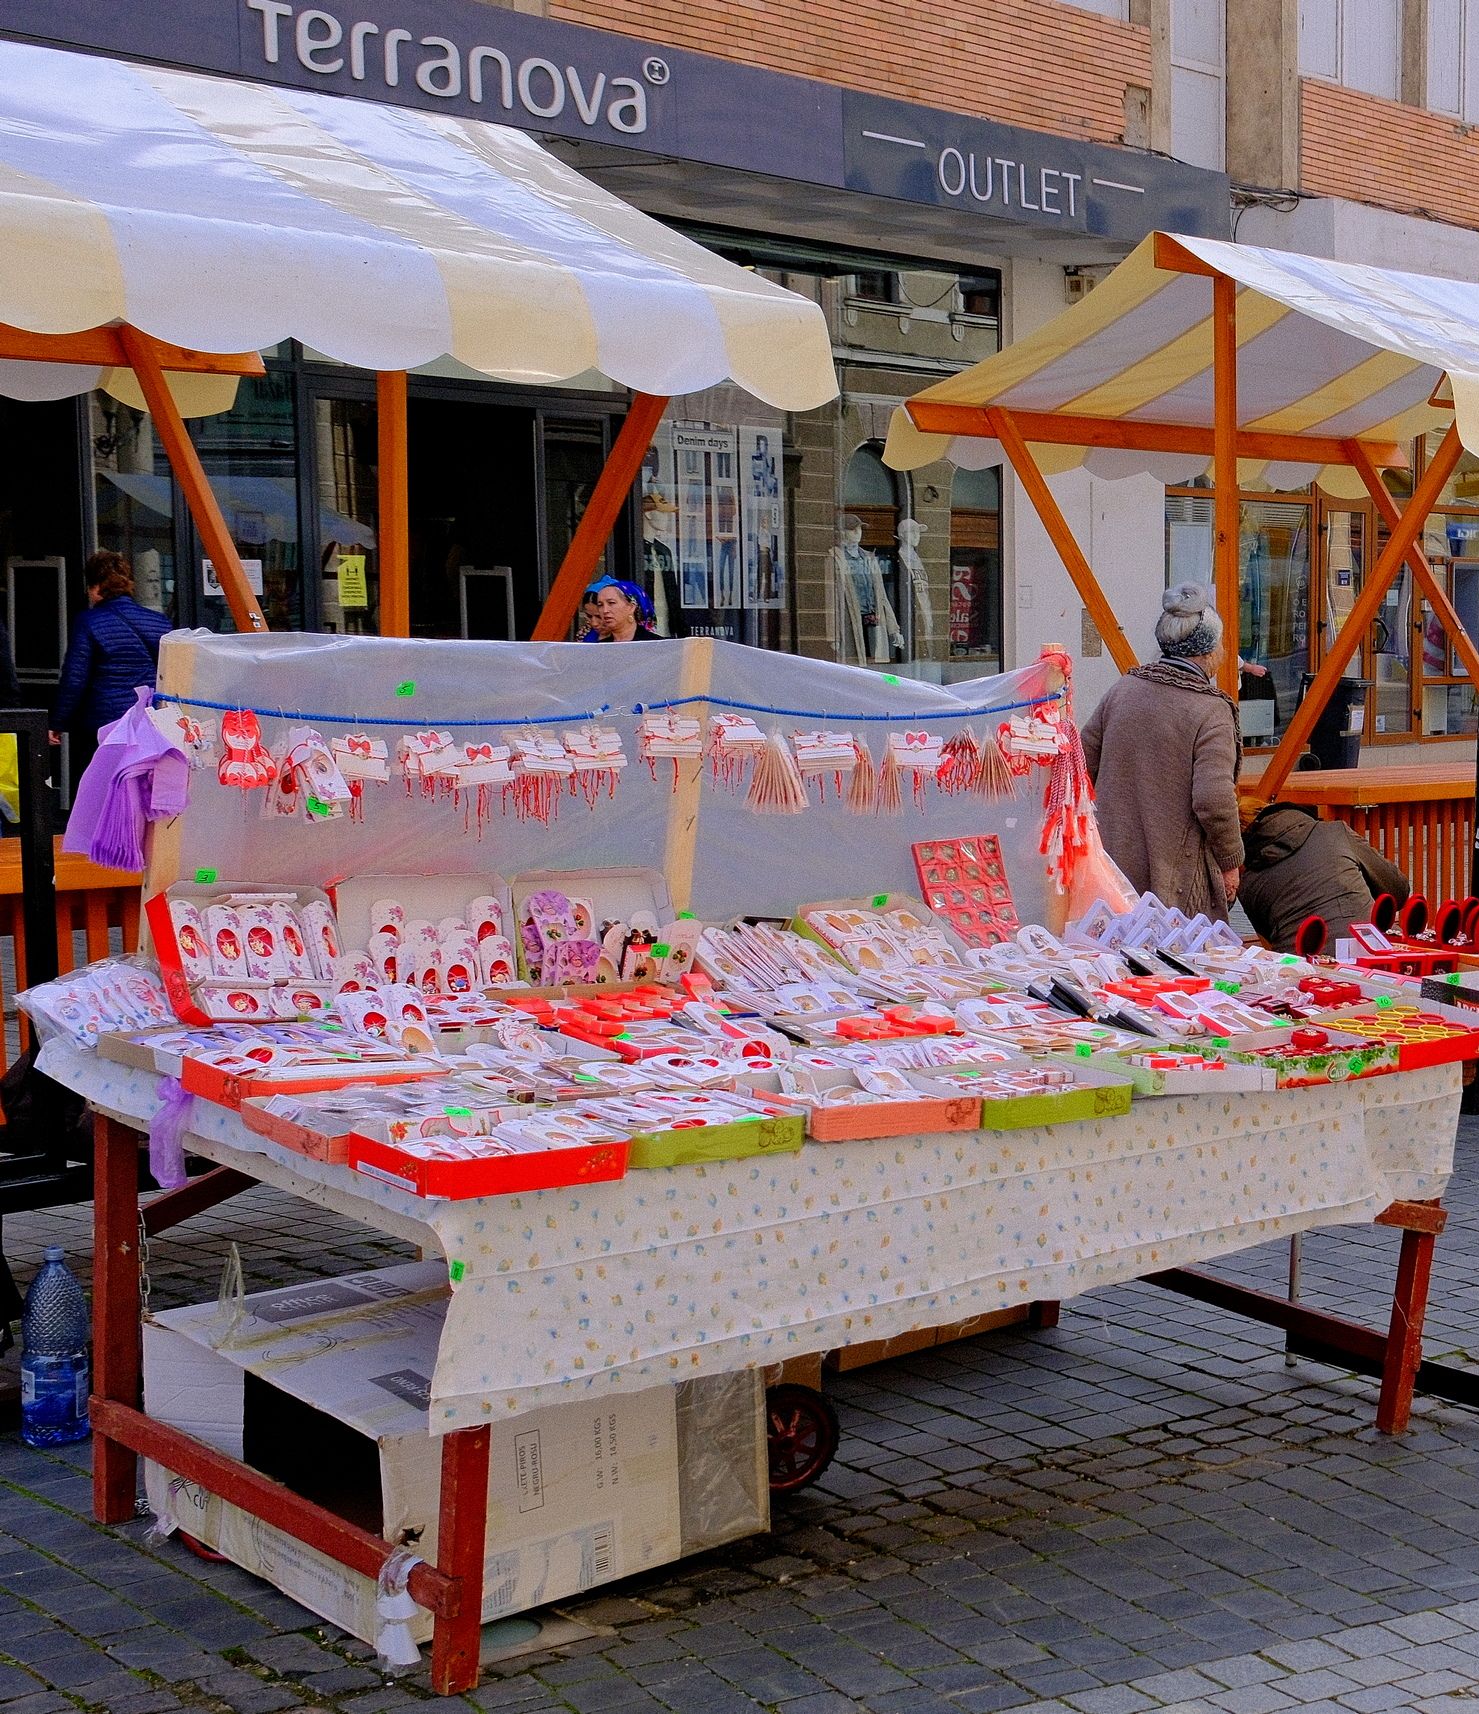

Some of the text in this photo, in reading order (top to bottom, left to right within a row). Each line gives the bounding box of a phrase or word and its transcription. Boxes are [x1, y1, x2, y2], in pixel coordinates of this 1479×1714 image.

[246, 0, 648, 134] Terranova
[937, 146, 1082, 217] OUTLET
[676, 434, 729, 450] Denim days
